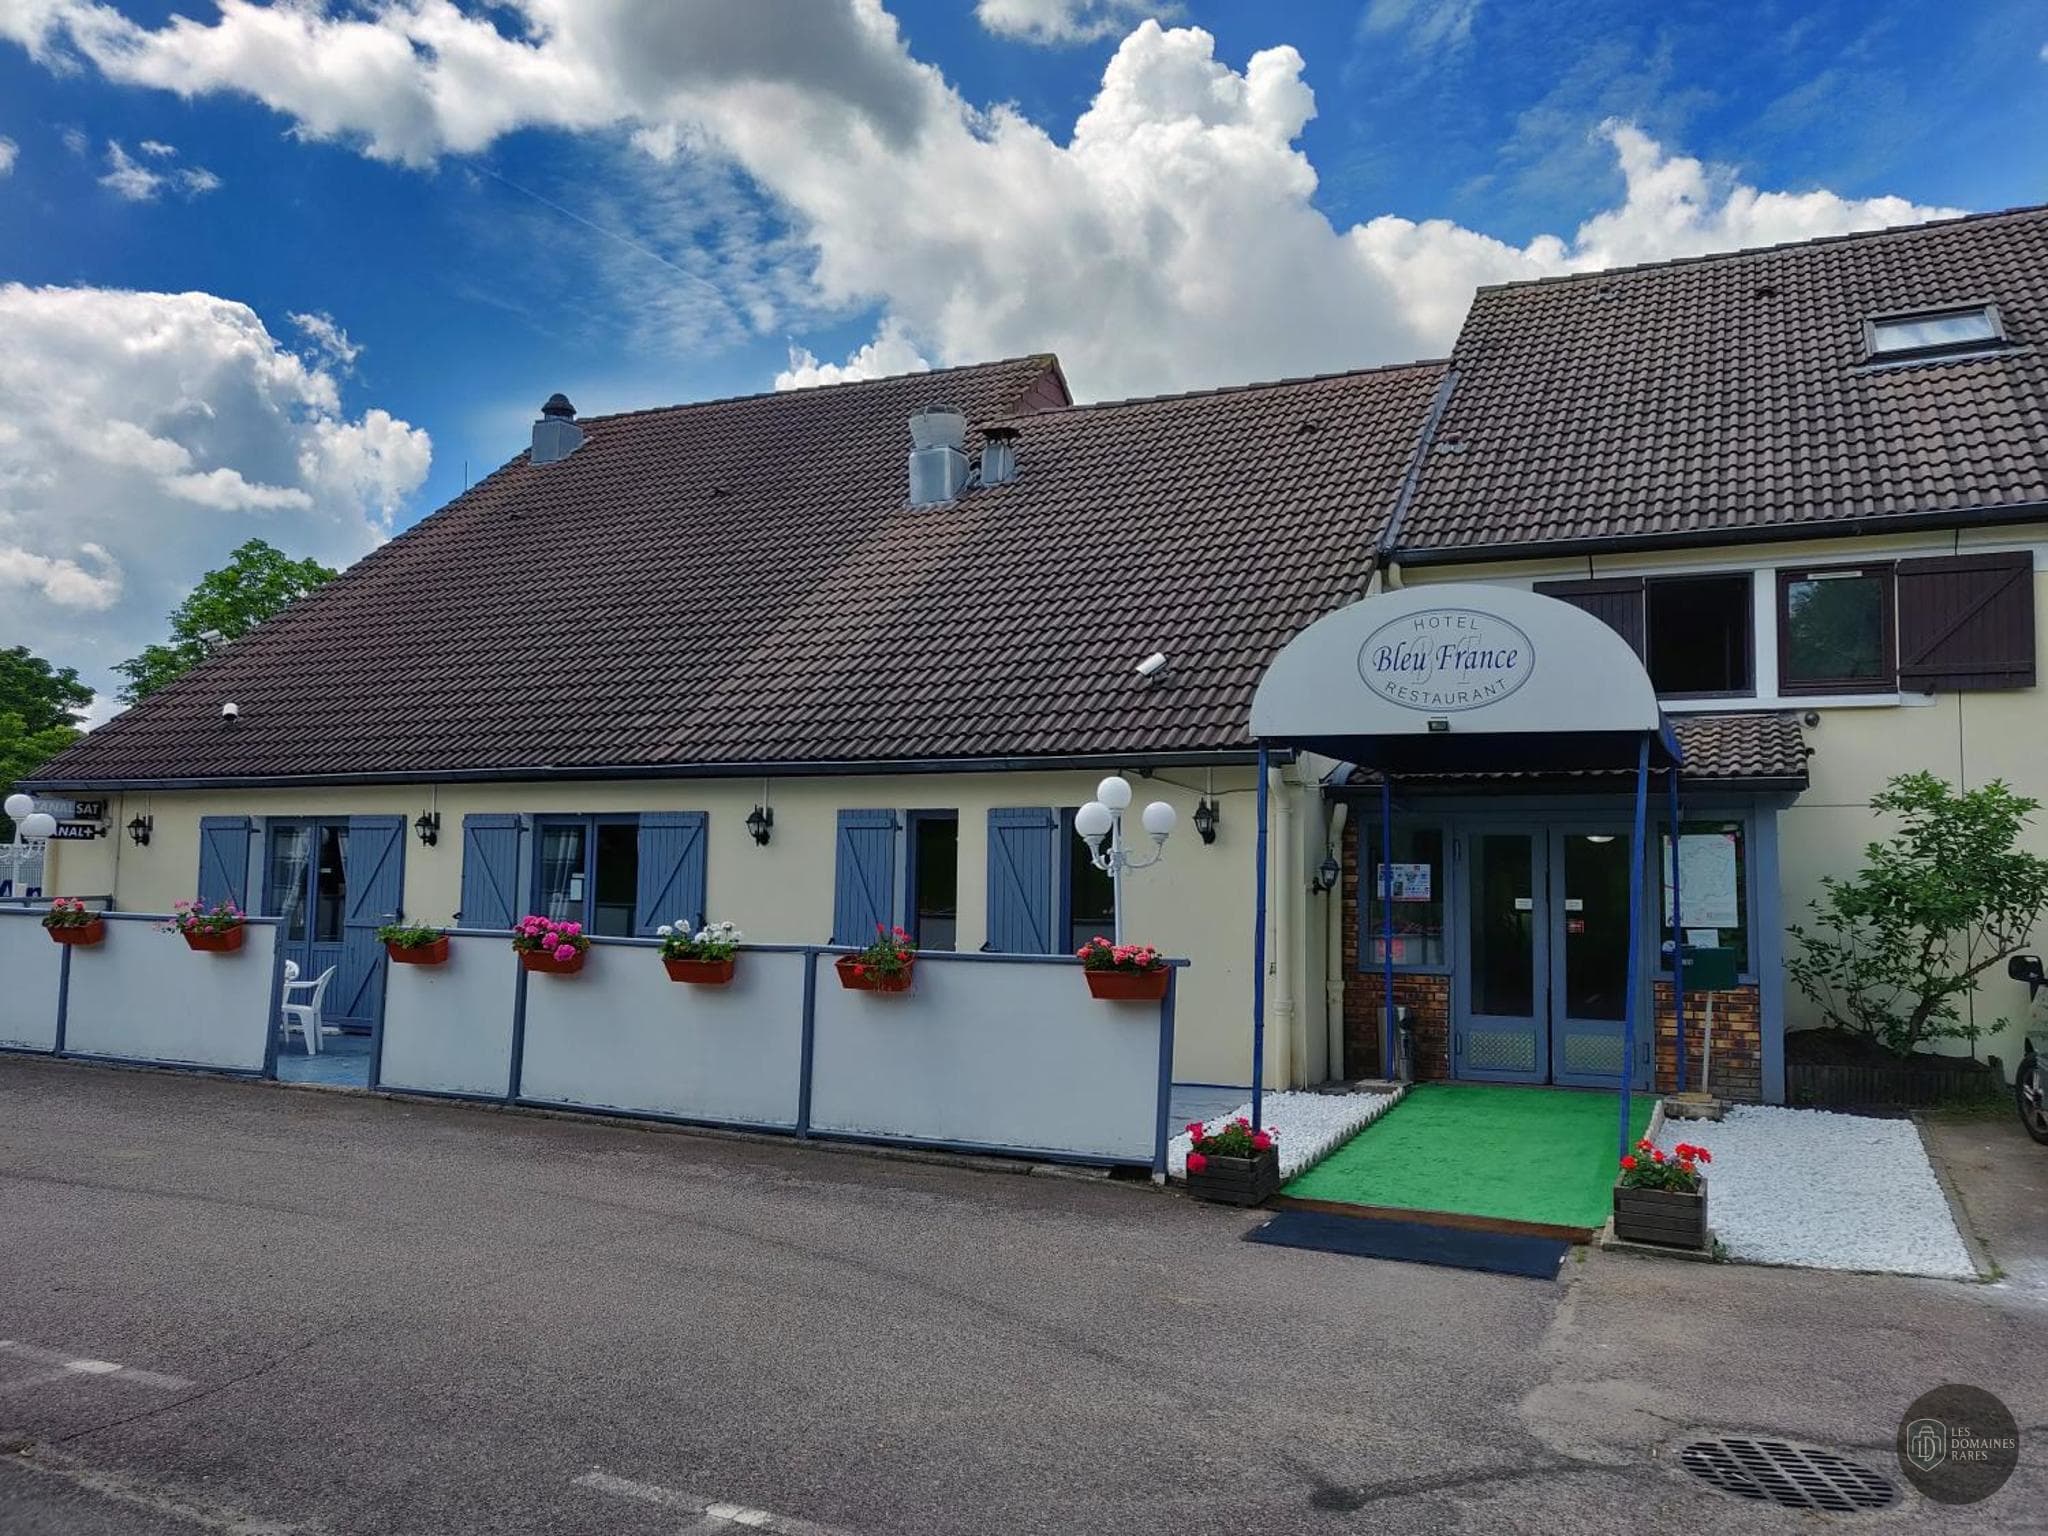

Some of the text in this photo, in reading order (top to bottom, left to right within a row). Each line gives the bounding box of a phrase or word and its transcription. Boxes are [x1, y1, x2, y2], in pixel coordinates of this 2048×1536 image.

[1413, 616, 1480, 631] HOTEL
[1373, 641, 1518, 671] Bleu France
[1385, 678, 1506, 705] RESTAURANT
